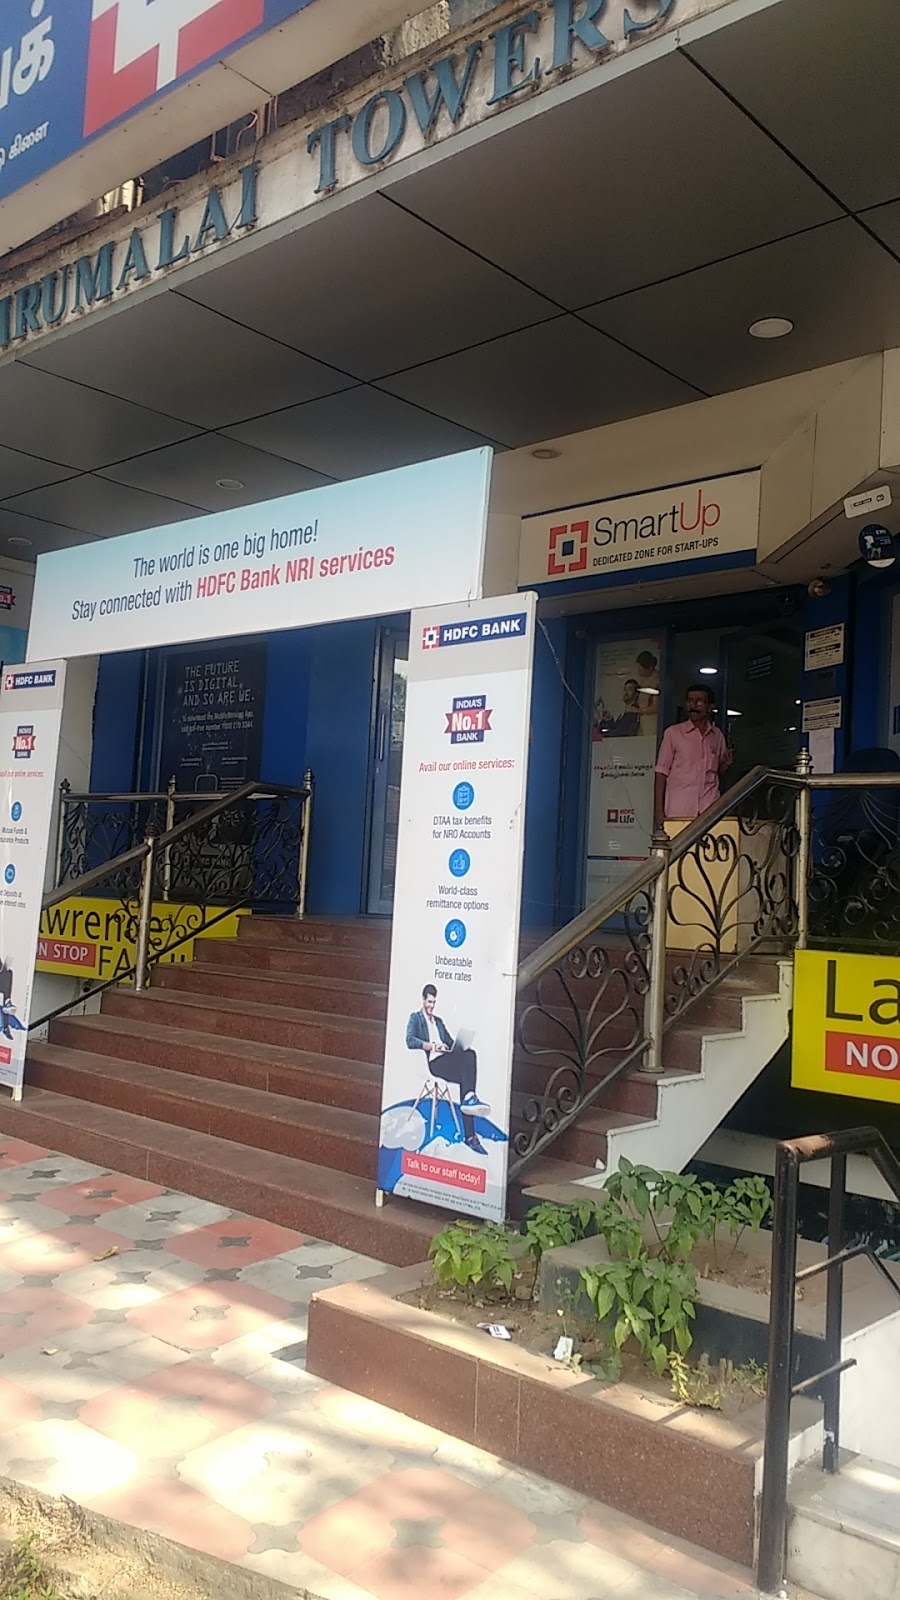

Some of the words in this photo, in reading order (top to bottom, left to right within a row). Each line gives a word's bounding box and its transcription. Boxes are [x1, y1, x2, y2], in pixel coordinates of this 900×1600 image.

[593, 489, 721, 546] SmartUp
[133, 557, 156, 578] The
[159, 546, 196, 573] world
[198, 544, 210, 565] is
[213, 541, 239, 562] one
[243, 532, 266, 558] big
[270, 519, 318, 551] home!
[593, 552, 632, 567] DEDICATED
[634, 548, 655, 560] ZONE
[657, 546, 673, 557] FOR
[674, 537, 719, 553] START-UPS
[72, 600, 97, 622] Stay
[99, 585, 162, 616] connected
[165, 580, 192, 604] with
[196, 571, 236, 599] HDFC
[240, 564, 281, 591] Bank
[285, 556, 315, 583] NRI
[319, 546, 395, 577] services
[443, 625, 479, 642] HDFC
[481, 619, 521, 636] BANK
[185, 665, 201, 678] THE
[205, 660, 240, 676] FUTURE
[15, 675, 33, 686] HDFC
[33, 673, 54, 684] BANK
[184, 680, 195, 692] IS
[183, 694, 200, 707] AND
[202, 693, 214, 705] SO
[217, 690, 236, 703] ARE
[239, 689, 255, 702] WE.
[456, 698, 482, 709] INDIA'S
[451, 711, 483, 732] No.1
[15, 736, 33, 751] No.1
[456, 732, 478, 742] BANK
[418, 762, 437, 773] Avail
[438, 763, 450, 772] our
[452, 760, 477, 771] online
[478, 758, 515, 770] services:
[433, 815, 451, 826] DTAA
[452, 816, 463, 826] tax
[464, 815, 492, 826] benefits
[620, 815, 635, 824] Life
[432, 829, 442, 839] for
[443, 829, 458, 839] NRO
[459, 829, 491, 839] Accounts
[438, 885, 478, 896] World-class
[426, 898, 462, 910] remittance
[463, 900, 490, 912] options
[53, 945, 89, 962] STOP
[435, 955, 473, 968] Unbeatable
[434, 968, 453, 980] Forex
[454, 970, 472, 982] rates
[407, 1158, 420, 1170] Talk
[421, 1163, 429, 1171] to
[430, 1165, 441, 1175] our
[441, 1167, 458, 1179] staff
[458, 1171, 481, 1186] today!
